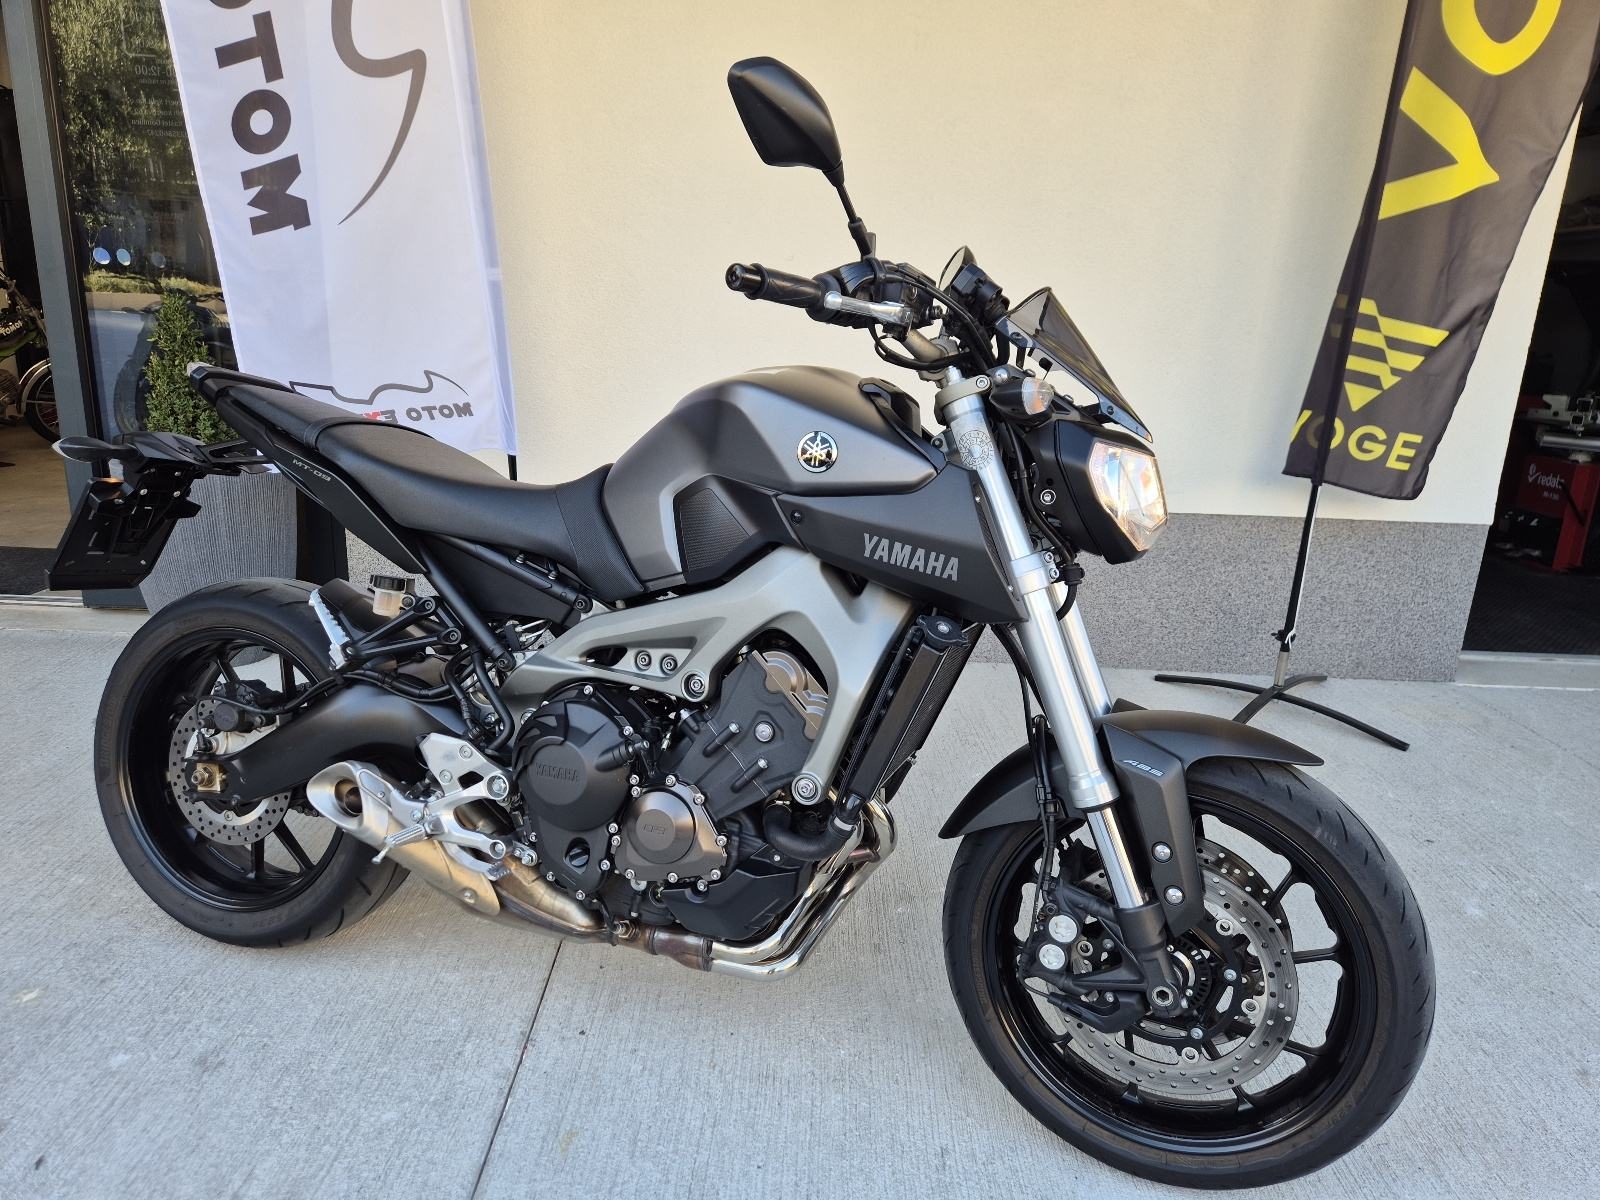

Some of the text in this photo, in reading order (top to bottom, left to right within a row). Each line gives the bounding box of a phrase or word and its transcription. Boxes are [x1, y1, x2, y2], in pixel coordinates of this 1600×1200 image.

[292, 458, 332, 482] MT-09
[863, 532, 959, 582] YAMAHA
[535, 762, 579, 782] YAMAHA
